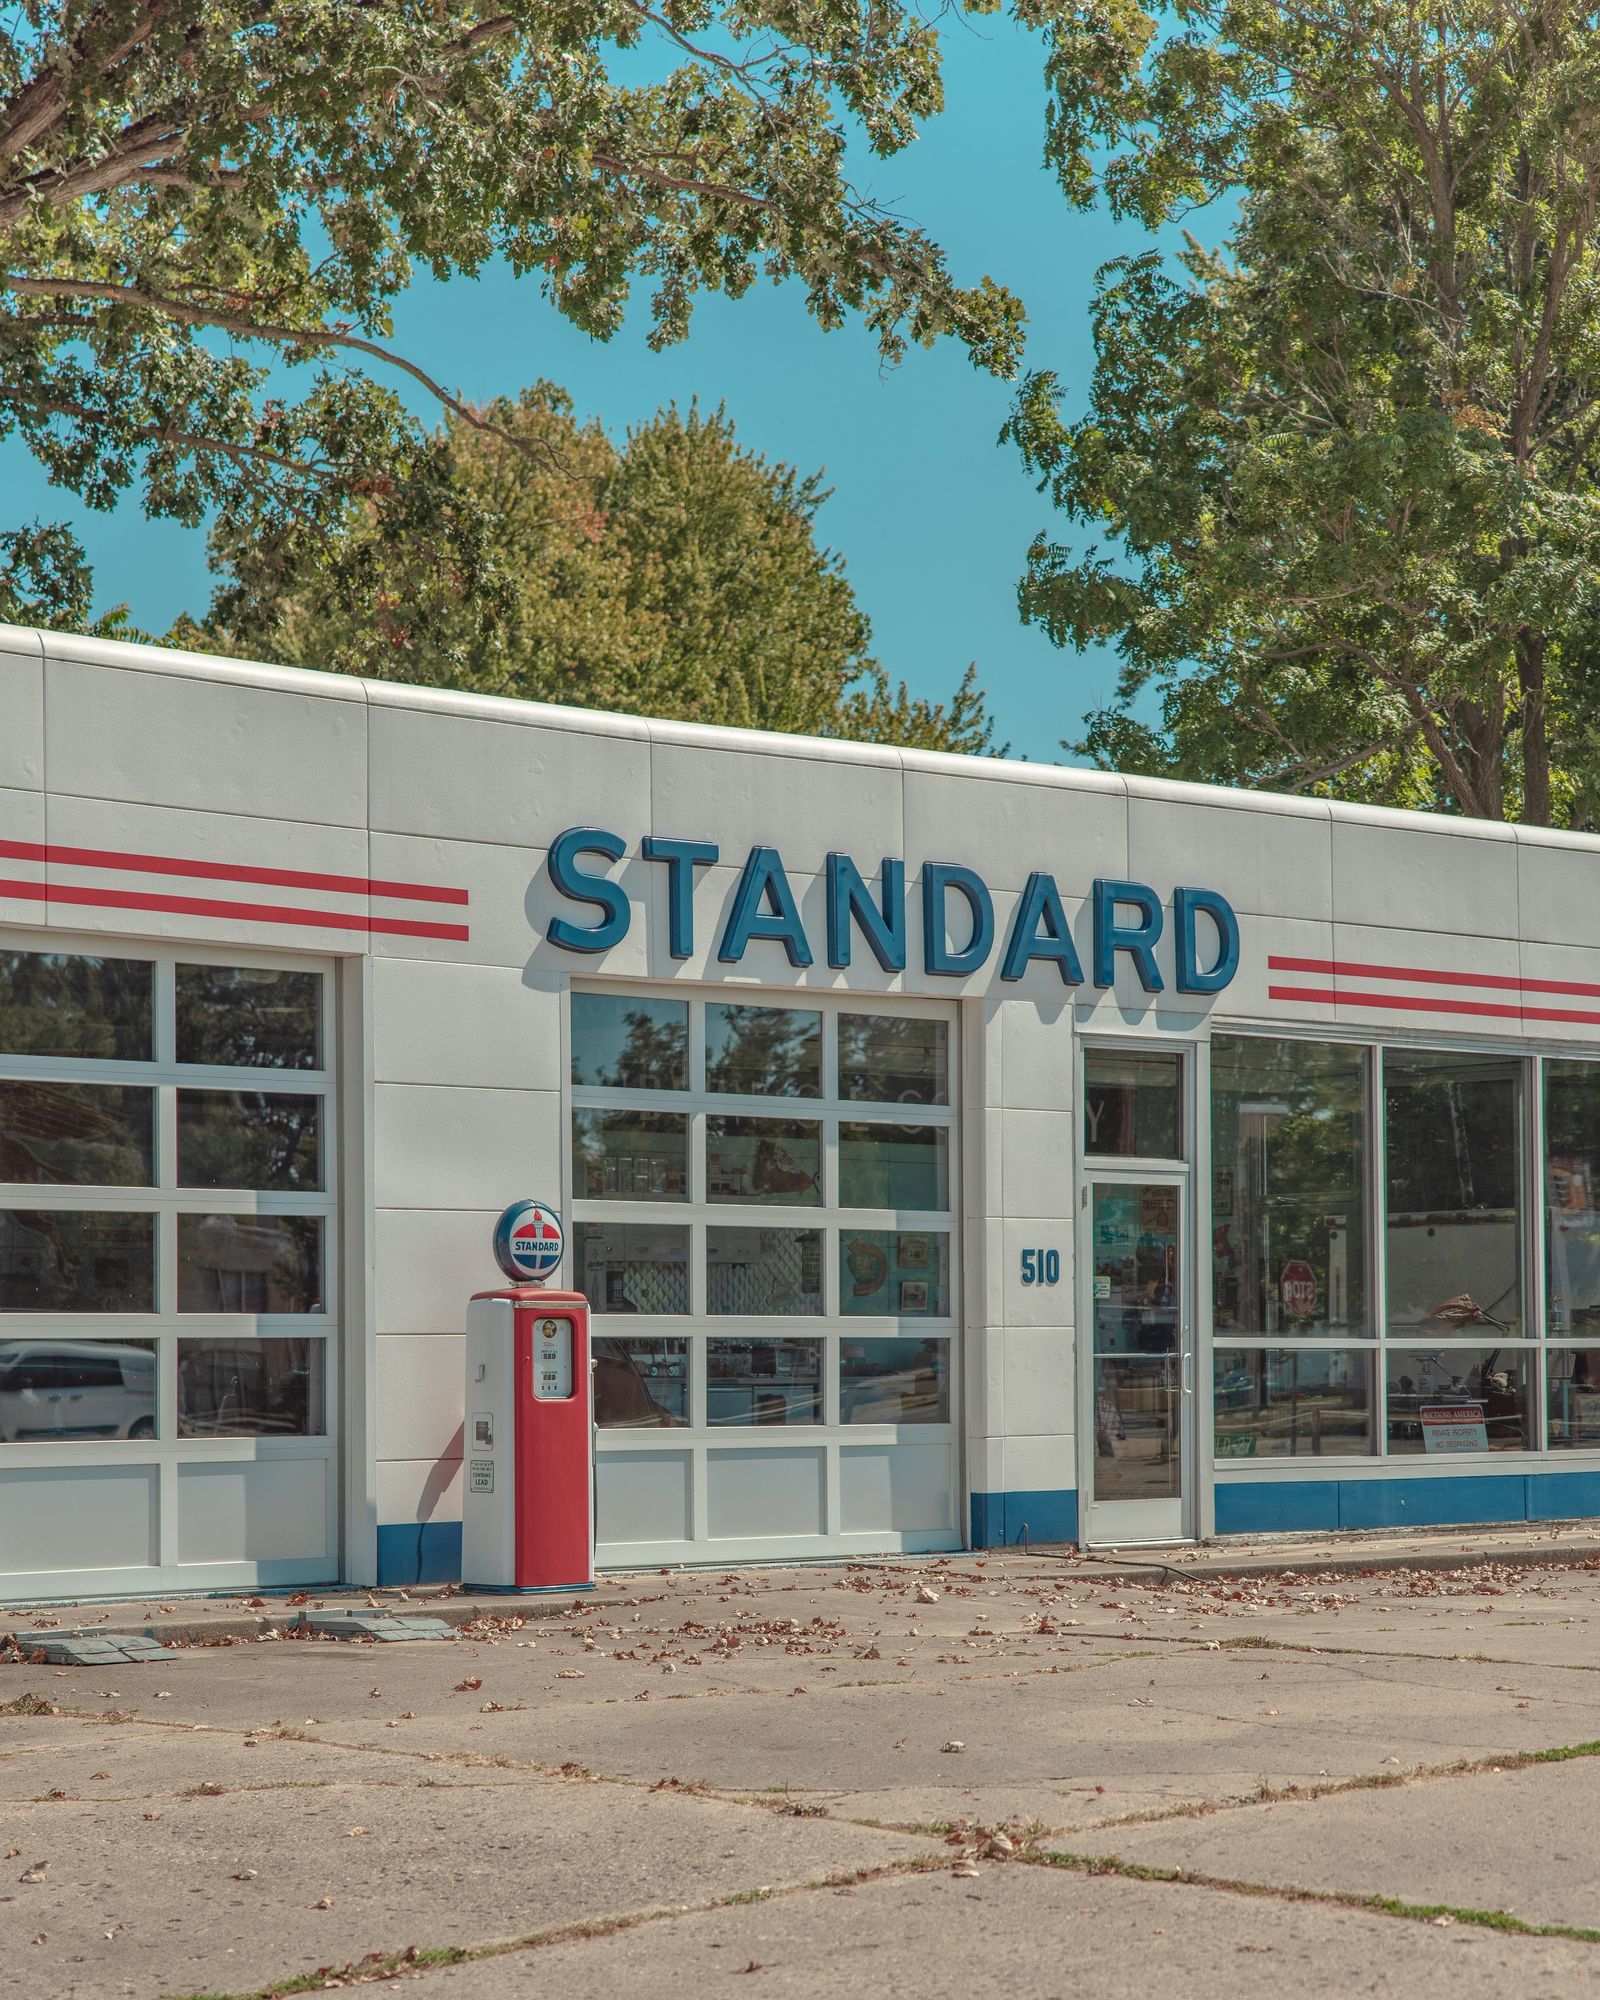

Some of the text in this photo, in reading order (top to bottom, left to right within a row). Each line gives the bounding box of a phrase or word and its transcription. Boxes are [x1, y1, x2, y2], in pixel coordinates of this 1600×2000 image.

[548, 826, 1240, 994] STANDARD
[515, 1241, 559, 1252] STANDARD
[1022, 1248, 1060, 1284] 510
[1454, 1410, 1482, 1418] AMERICA
[1453, 1428, 1477, 1436] PROPERTY
